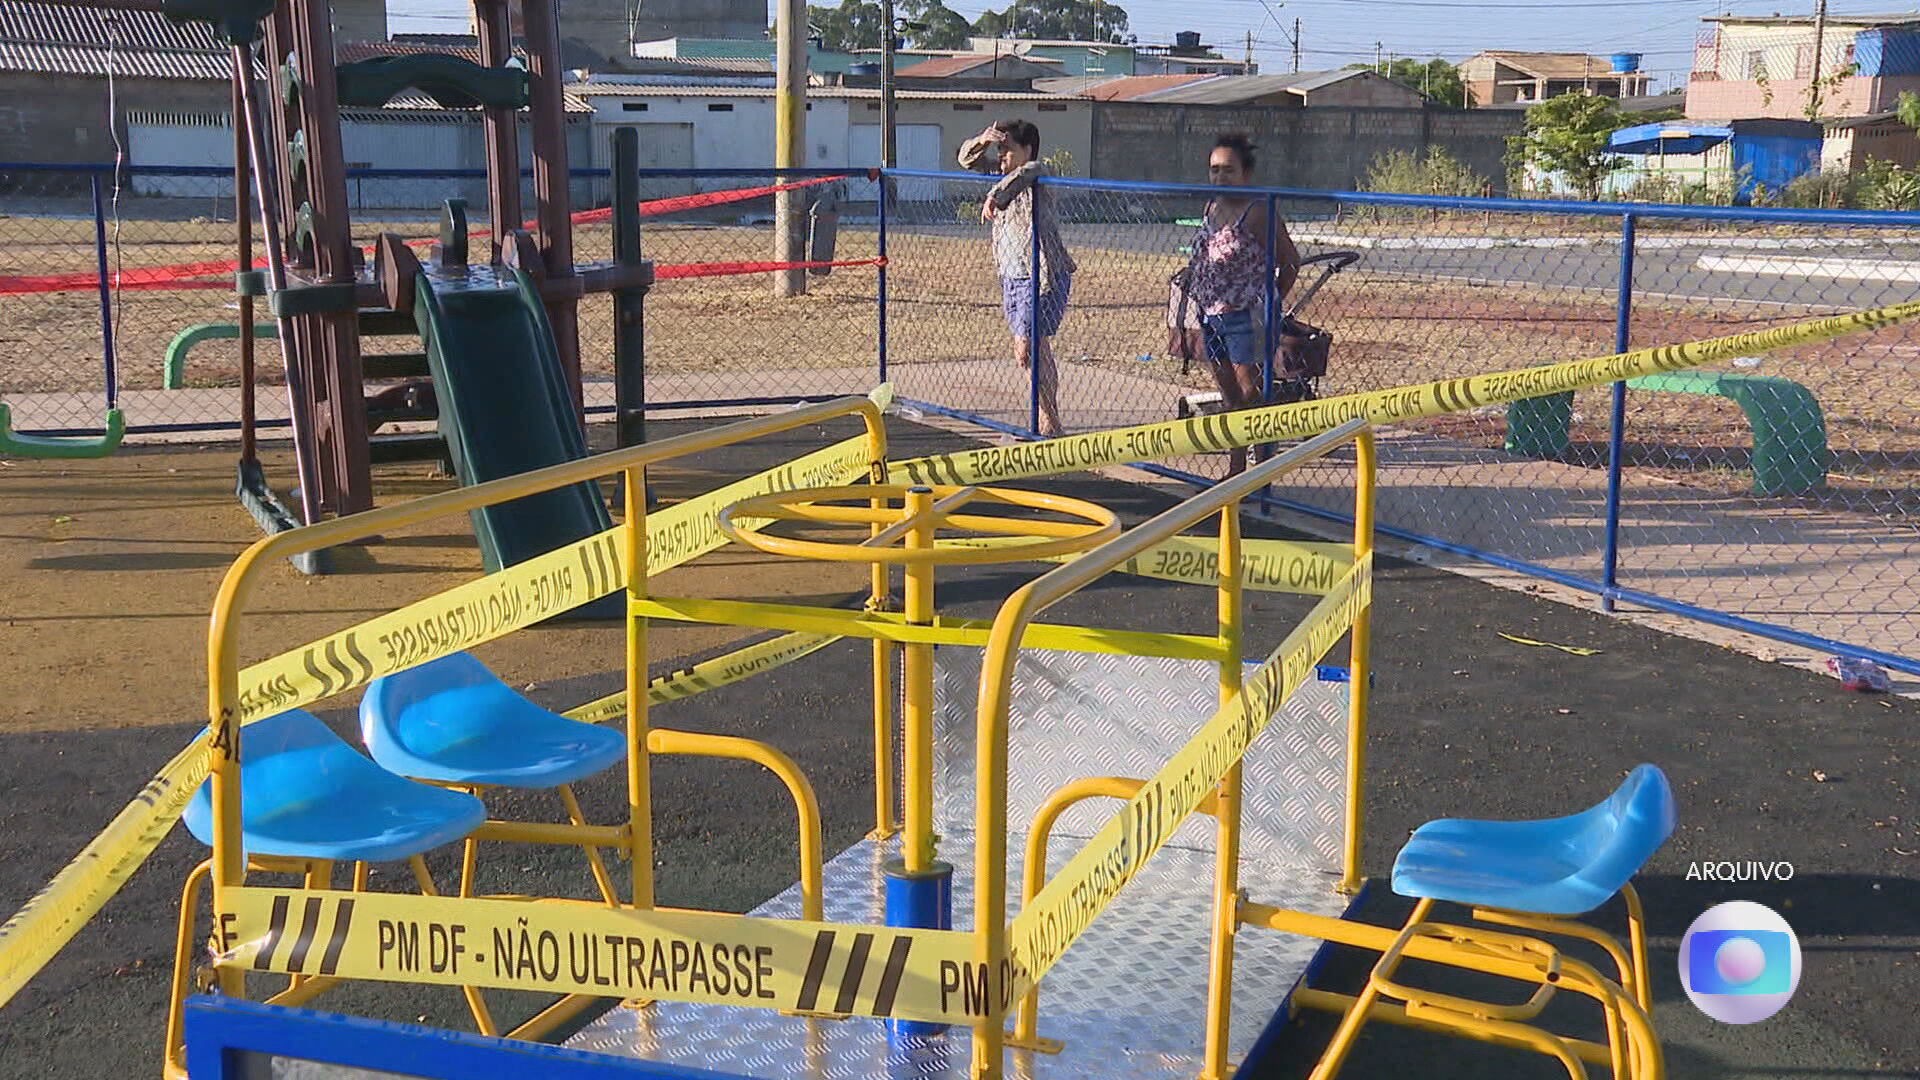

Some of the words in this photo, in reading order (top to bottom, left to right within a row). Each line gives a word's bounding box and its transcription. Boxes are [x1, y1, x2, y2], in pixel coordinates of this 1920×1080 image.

[378, 919, 419, 973] PM
[429, 922, 466, 975] DF
[493, 916, 560, 982] NÃO
[569, 931, 775, 999] ULTRAPASSE
[940, 959, 990, 1018] PM
[1028, 911, 1059, 982] NÃO
[1058, 838, 1129, 949] ULTRAPASSE
